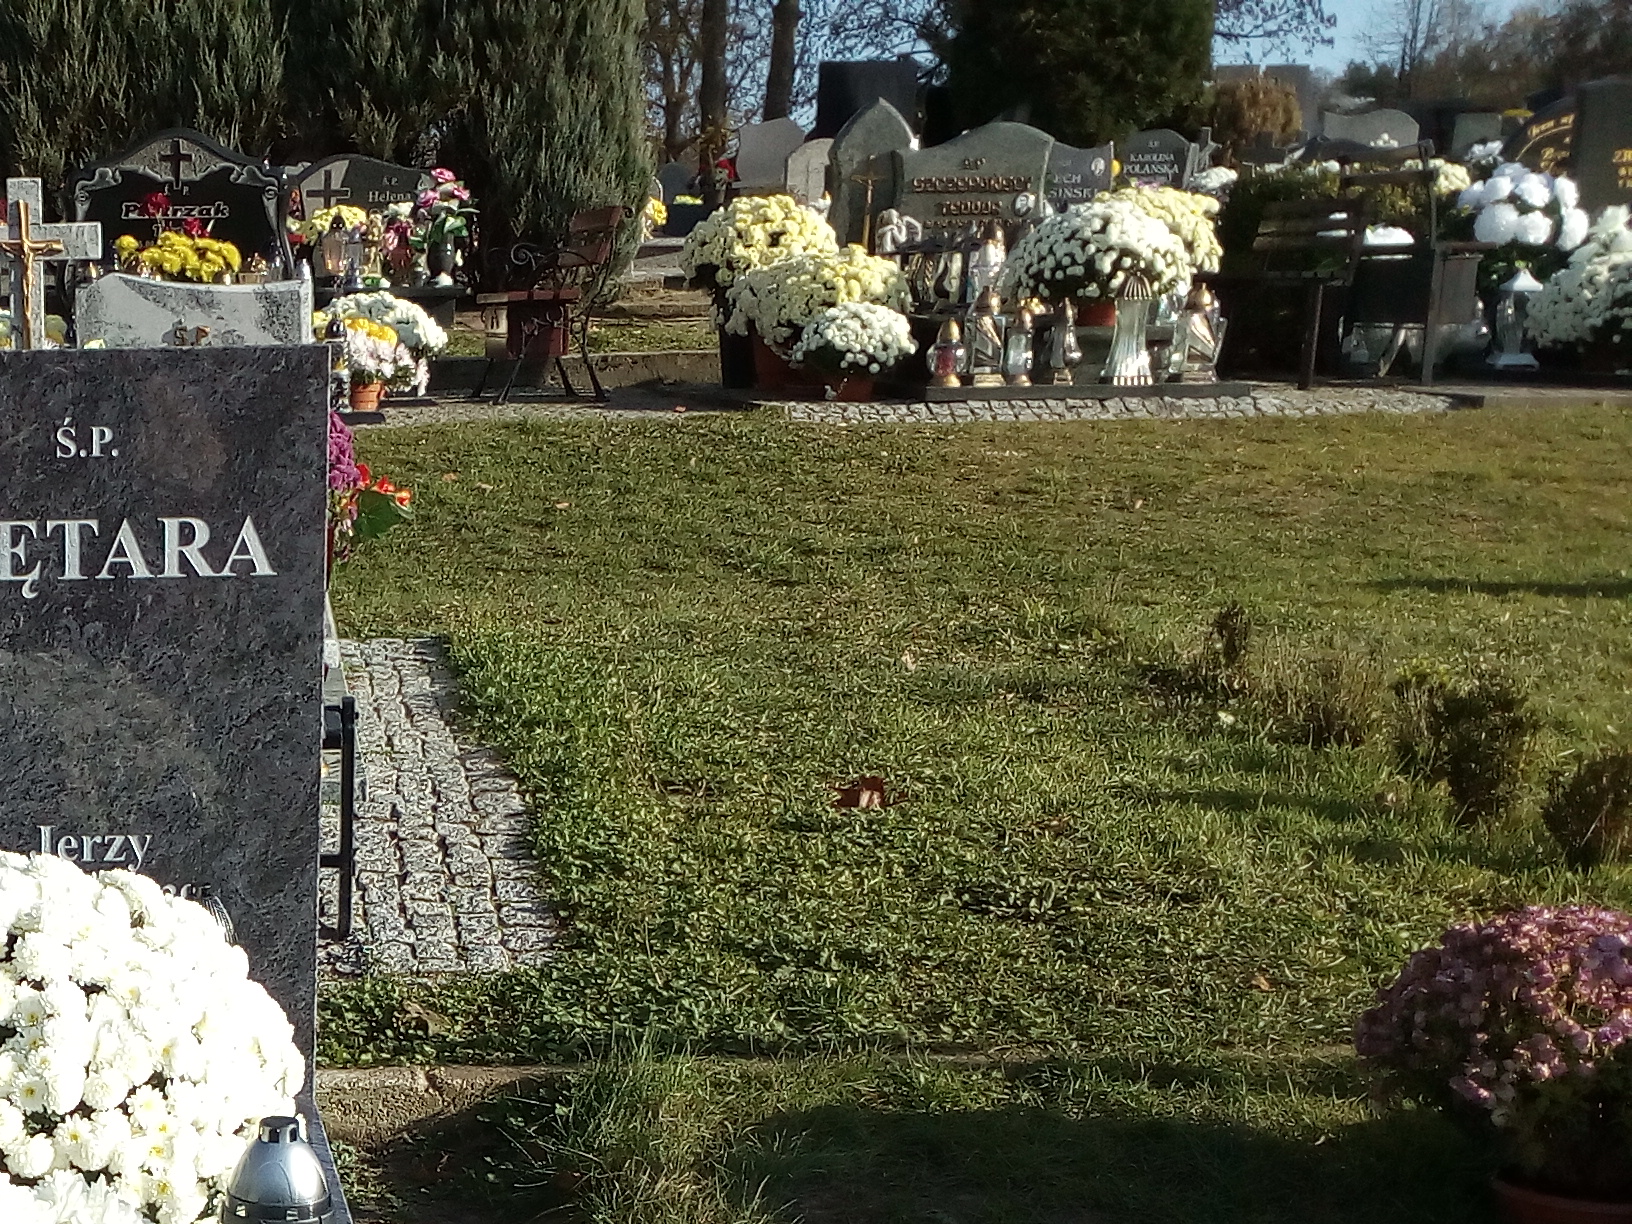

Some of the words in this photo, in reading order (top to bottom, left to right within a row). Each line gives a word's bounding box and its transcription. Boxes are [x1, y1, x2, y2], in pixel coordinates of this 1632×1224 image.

[368, 190, 412, 203] Helena
[55, 416, 120, 459] Ś.P.
[34, 825, 153, 872] Jerzy
